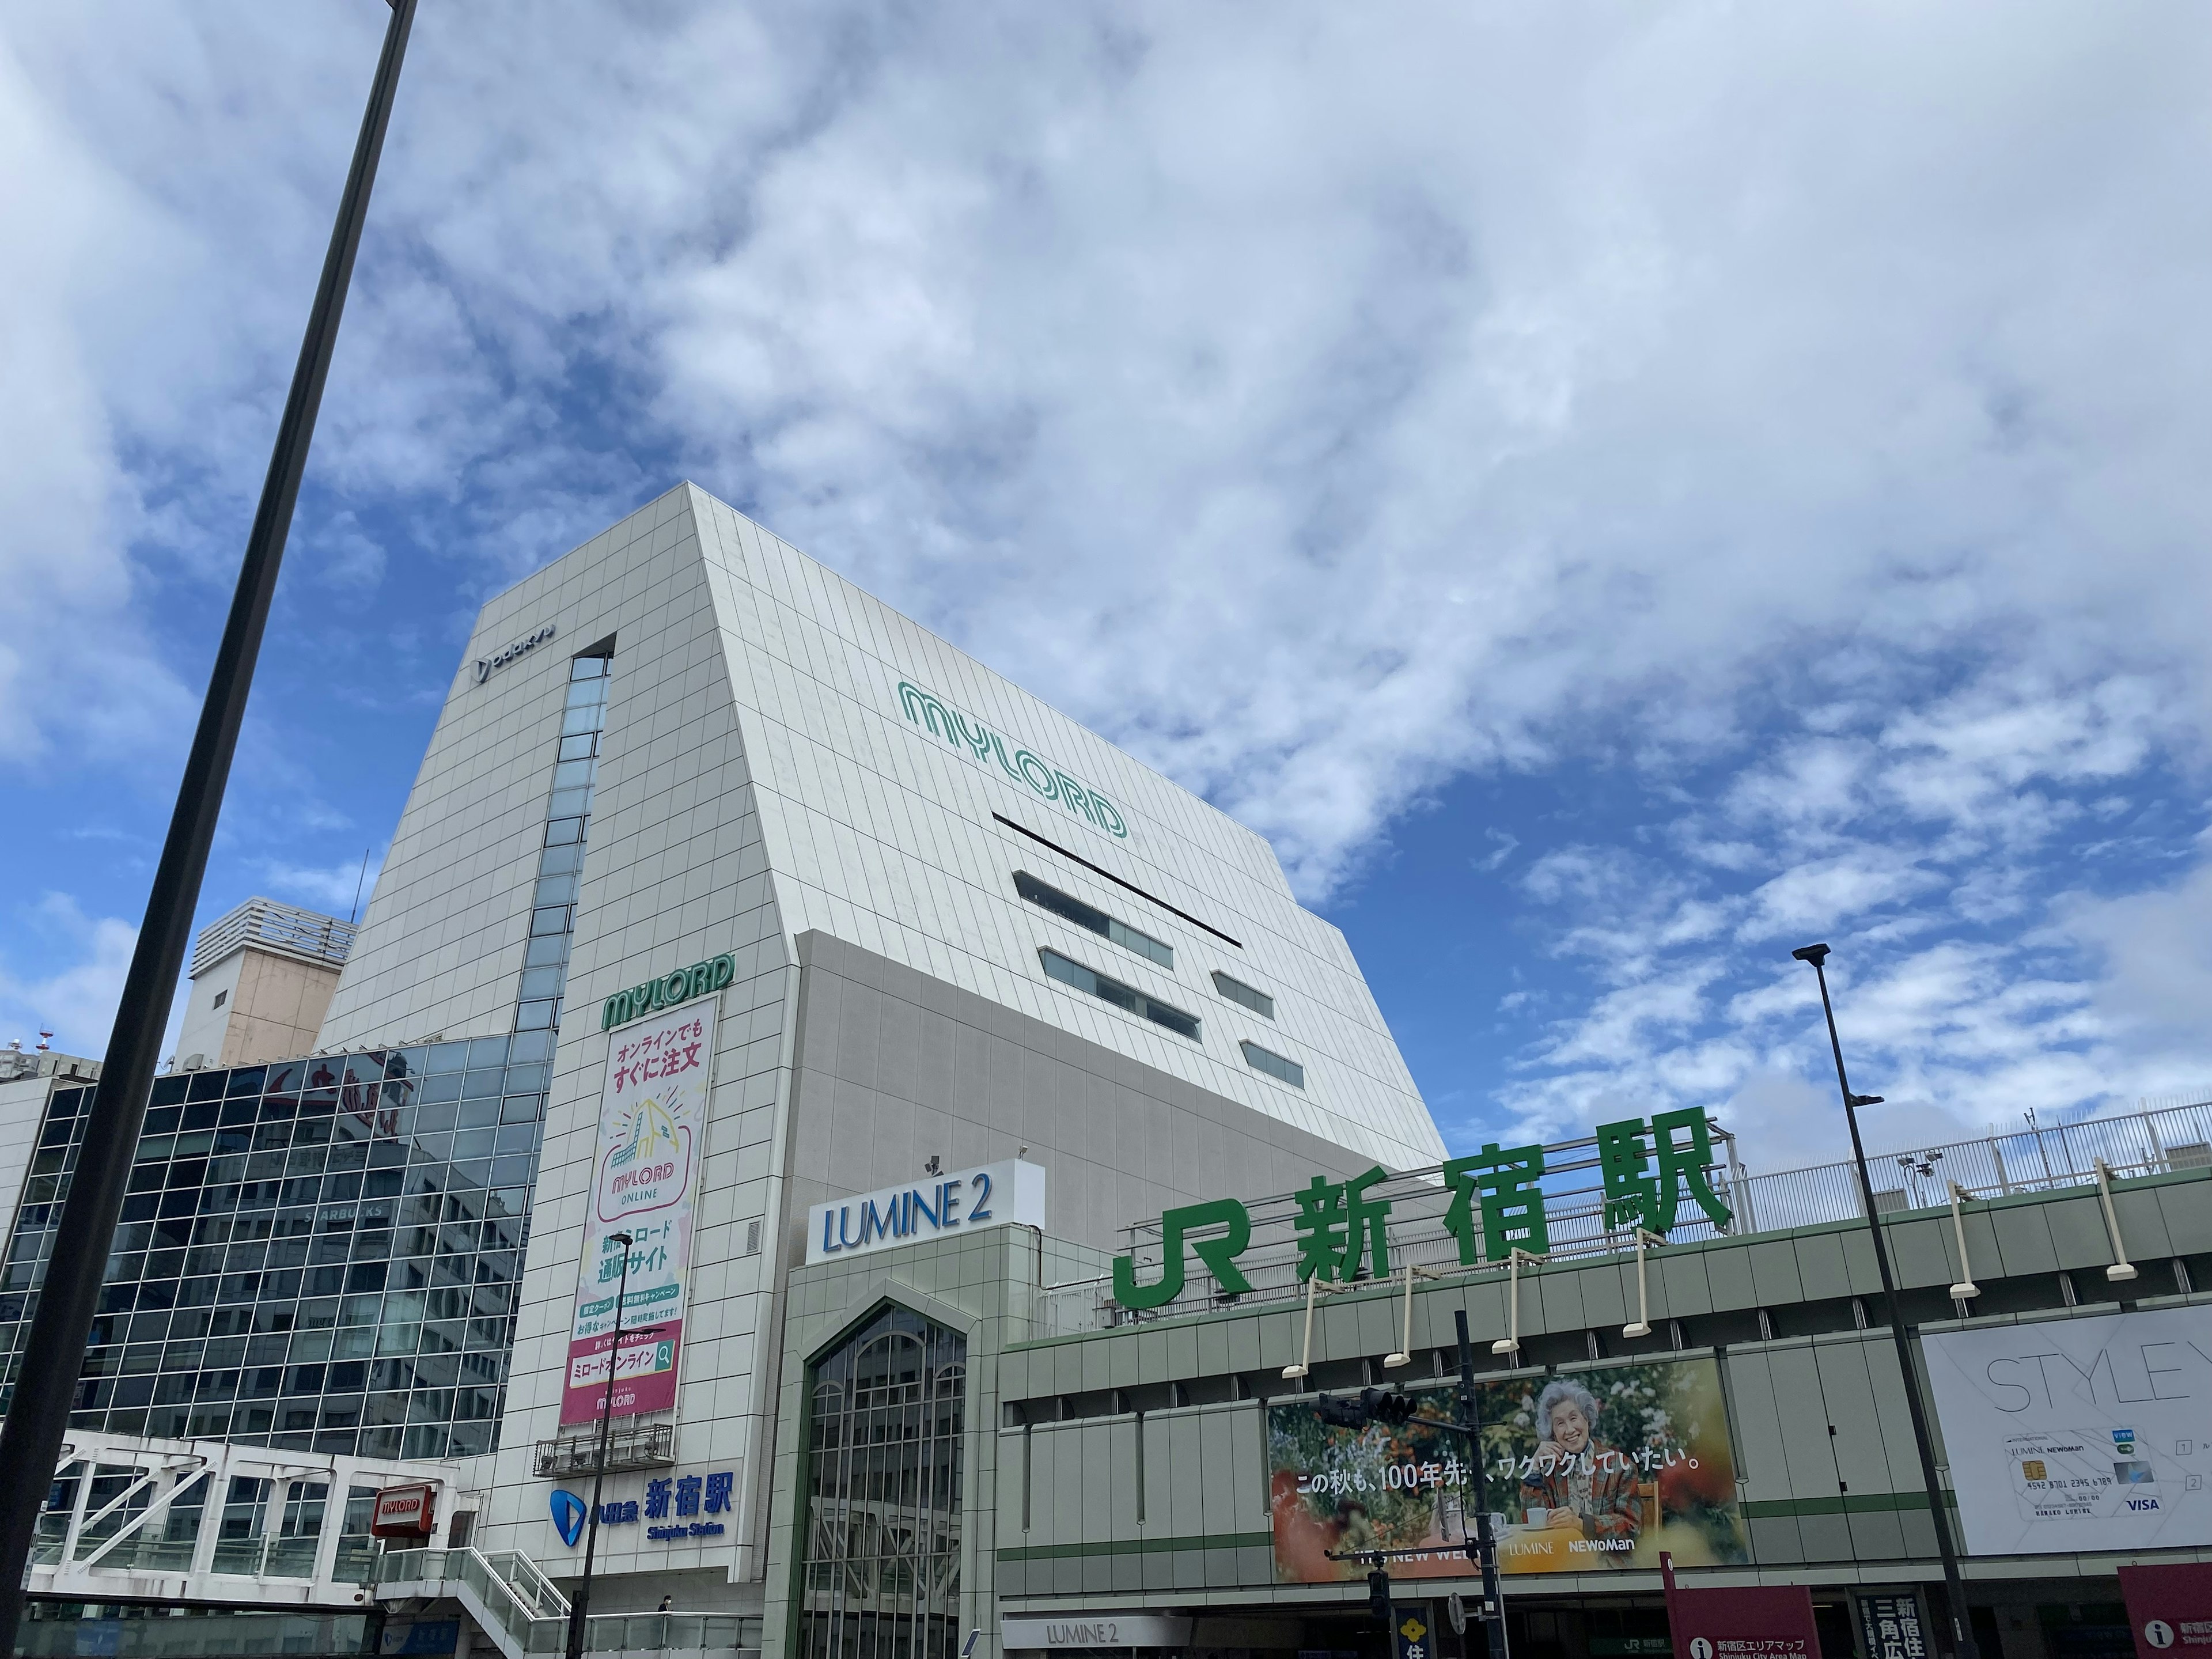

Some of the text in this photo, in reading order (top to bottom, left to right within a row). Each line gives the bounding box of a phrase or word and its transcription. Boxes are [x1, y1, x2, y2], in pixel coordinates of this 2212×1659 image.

[898, 681, 1127, 838] MYLORD
[601, 953, 735, 1030] MYLORD
[617, 1018, 703, 1063] オンラインでも
[614, 1041, 702, 1094] すぐに注文
[612, 1162, 674, 1194] MYLORD
[622, 1188, 657, 1205] ONLINE
[1112, 1106, 1733, 1309] JR 新宿駅
[823, 1173, 993, 1252] LUMINE 2
[598, 1245, 667, 1285] 通販サイト
[597, 1393, 635, 1410] MLORD
[382, 1499, 420, 1514] MYLORD
[645, 1472, 733, 1519] 新宿駅
[2126, 1499, 2160, 1511] VISA
[647, 1521, 725, 1541] Shinjuku Station
[1509, 1539, 1635, 1555] LUMINE NEWoMan
[1047, 1623, 1119, 1643] LUMINE 2
[1624, 1639, 1640, 1650] JR
[1717, 1639, 1804, 1652] 新宿区エリアマップ
